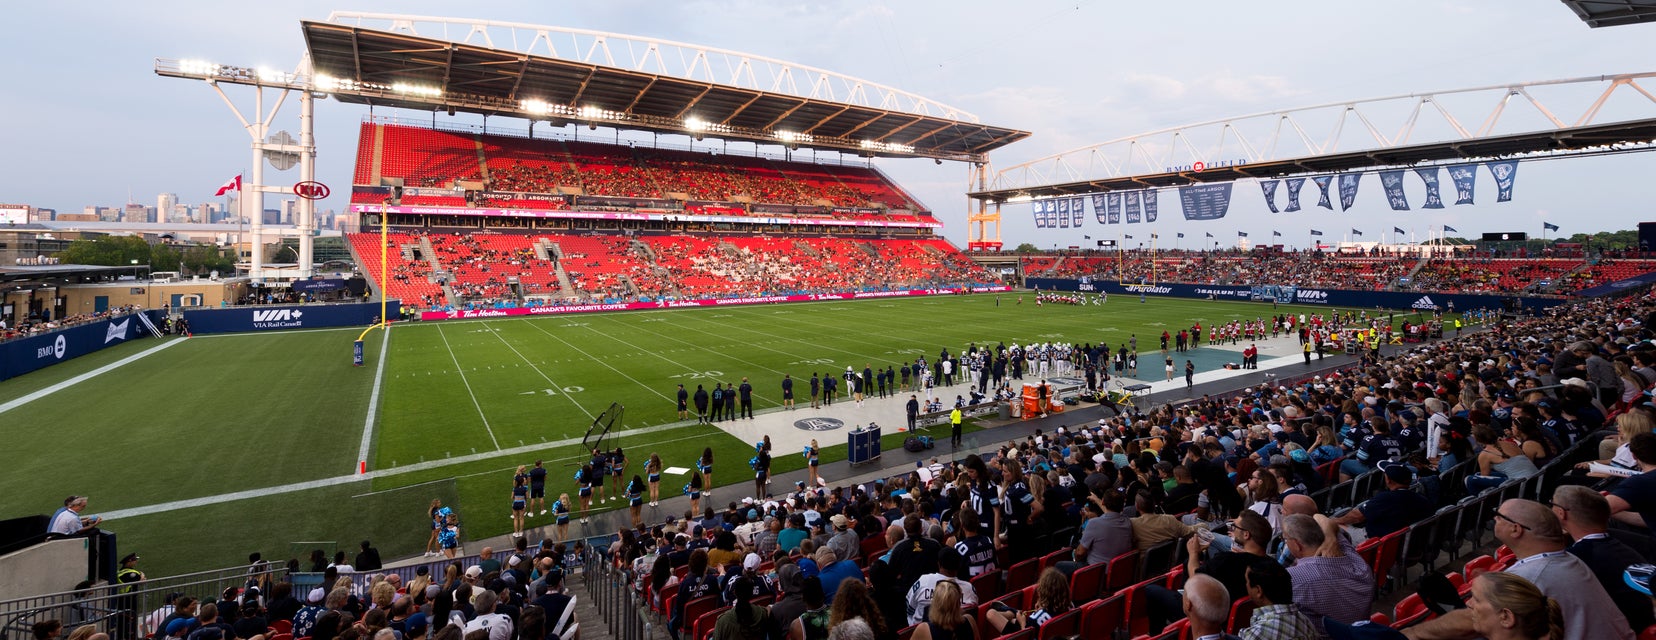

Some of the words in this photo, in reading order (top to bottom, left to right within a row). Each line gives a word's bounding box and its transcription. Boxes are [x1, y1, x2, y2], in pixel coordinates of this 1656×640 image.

[1166, 165, 1191, 173] BMO
[1206, 158, 1246, 168] FIELD
[300, 184, 325, 196] KIA
[1133, 285, 1172, 293] Purolator
[1297, 290, 1320, 298] VIA
[253, 309, 290, 321] VIA
[478, 309, 508, 317] Hortons
[37, 345, 53, 359] BMO
[684, 370, 724, 379] 20
[542, 386, 585, 396] 10
